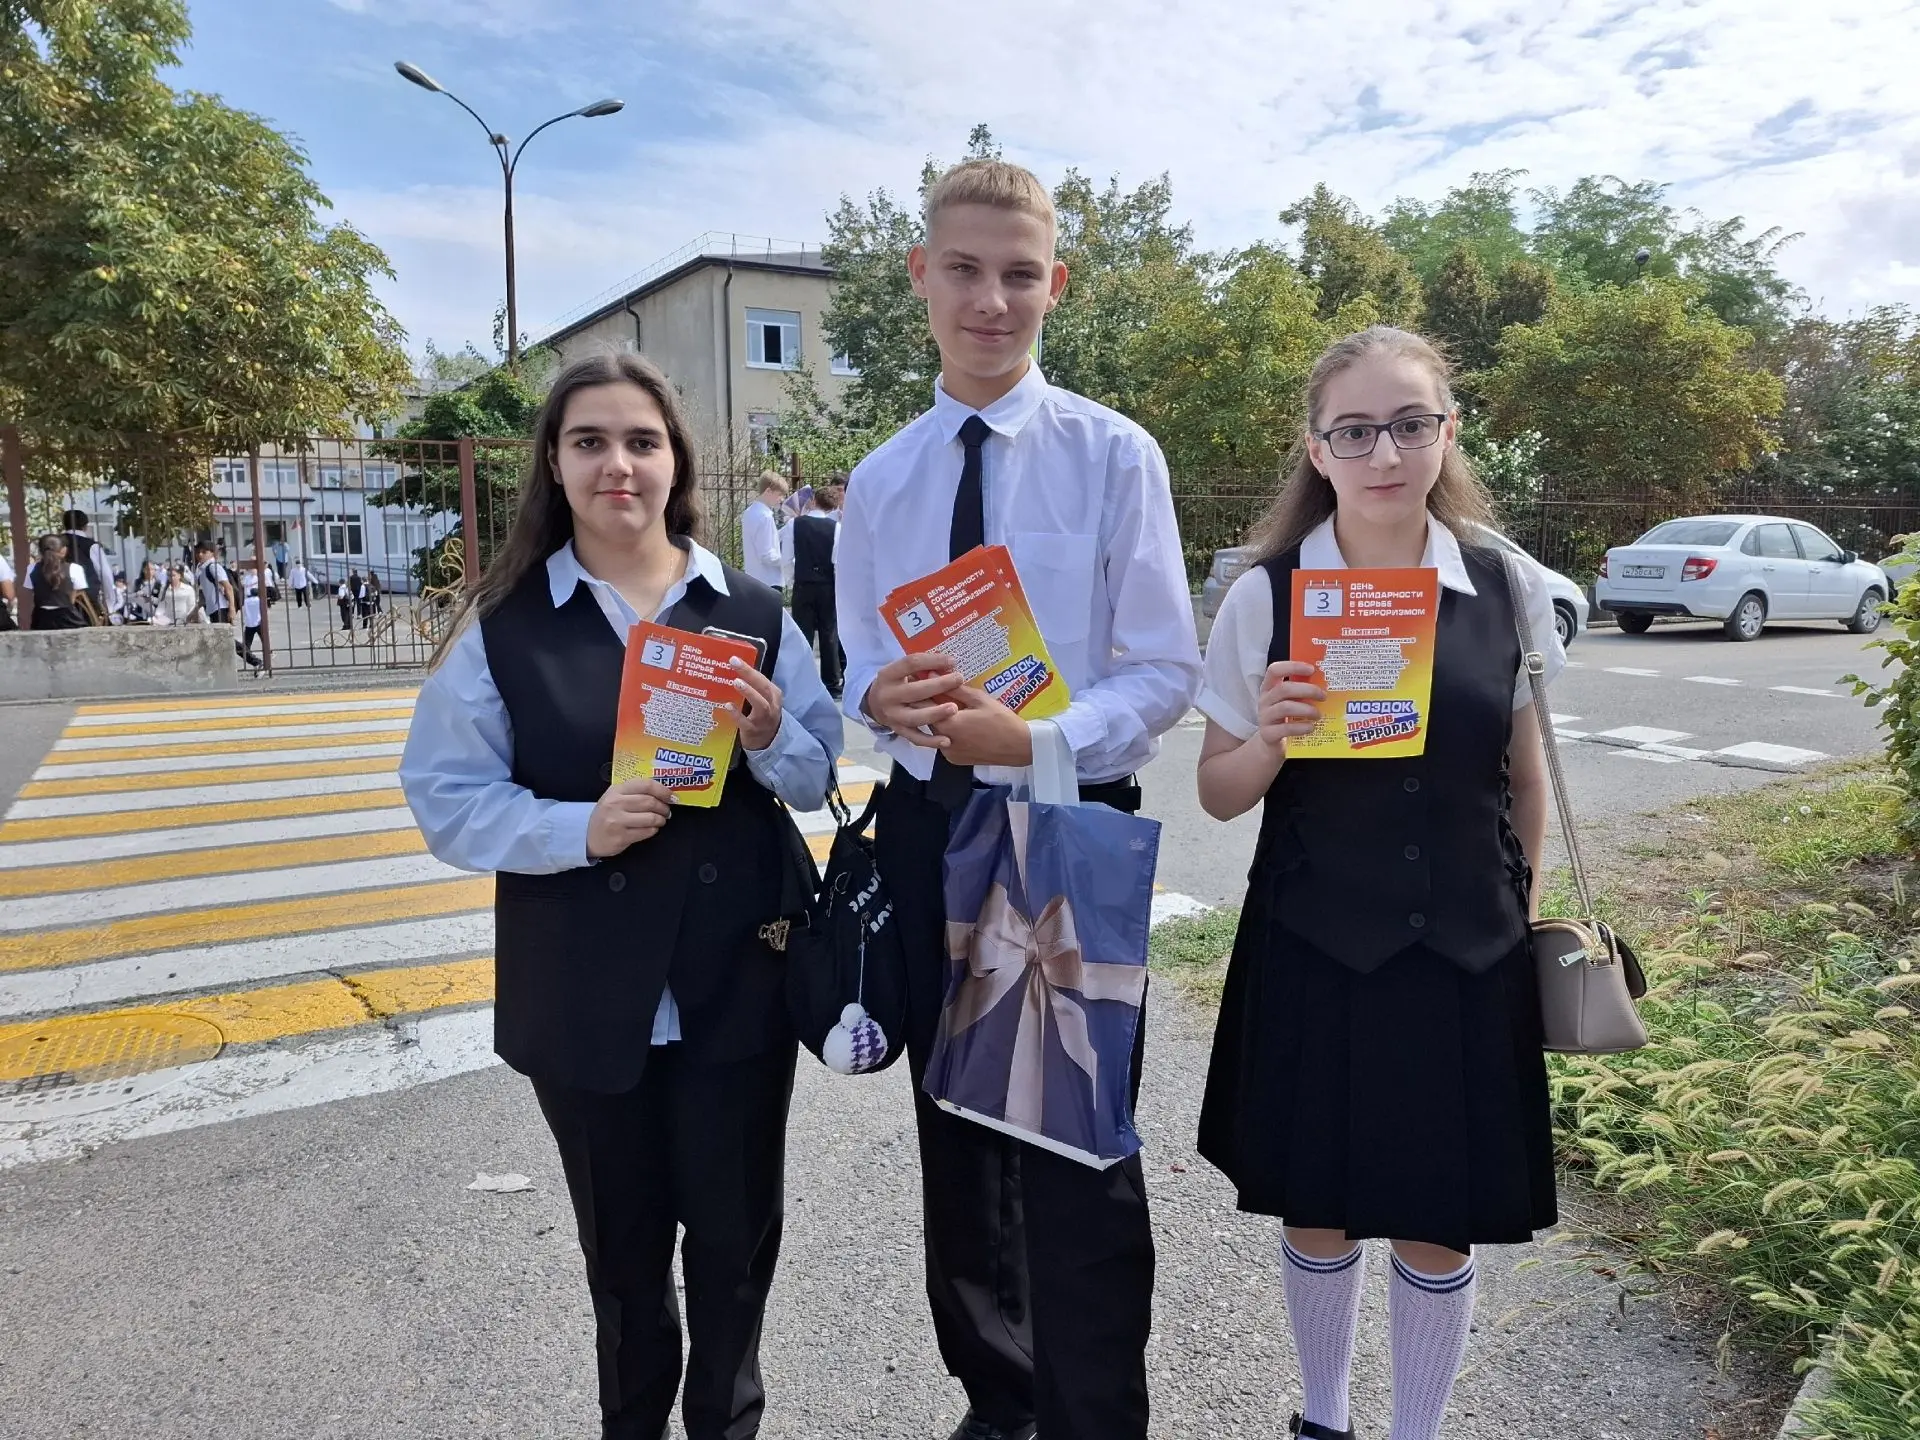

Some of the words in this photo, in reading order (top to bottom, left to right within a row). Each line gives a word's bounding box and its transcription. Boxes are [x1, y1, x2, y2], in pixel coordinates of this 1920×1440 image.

[927, 585, 945, 599] ДЕНЬ
[930, 568, 985, 605] СОЛИДАРНОСТИ
[1349, 591, 1424, 599] СОЛИДАРНОСТИ
[940, 589, 967, 608] БОРЬБЕ
[945, 580, 996, 614] ТЕРРОРИЗМОМ
[1316, 591, 1330, 610] 3
[1349, 600, 1356, 608] В
[1357, 600, 1392, 608] БОРЬБЕ
[907, 611, 922, 627] 3
[1349, 609, 1356, 617] С
[1359, 608, 1426, 617] ТЕРРОРИЗМОМ
[652, 645, 664, 661] 3
[682, 644, 703, 654] ДЕНЬ
[680, 652, 731, 670] СОЛИДАРНОС
[685, 661, 715, 674] БОРЬБЕ
[684, 668, 735, 687] ТЕРРОРИЗМО
[985, 656, 1036, 693] МОЗДОК
[1005, 670, 1048, 710] ЕРРОРА!
[1348, 702, 1412, 713] МОЗДОК
[1347, 714, 1394, 731] ПРОТИВ
[1348, 721, 1414, 743] ТЕРРОРА!
[657, 749, 711, 768] МОЗДОК
[653, 767, 694, 776] ПРОТИВ
